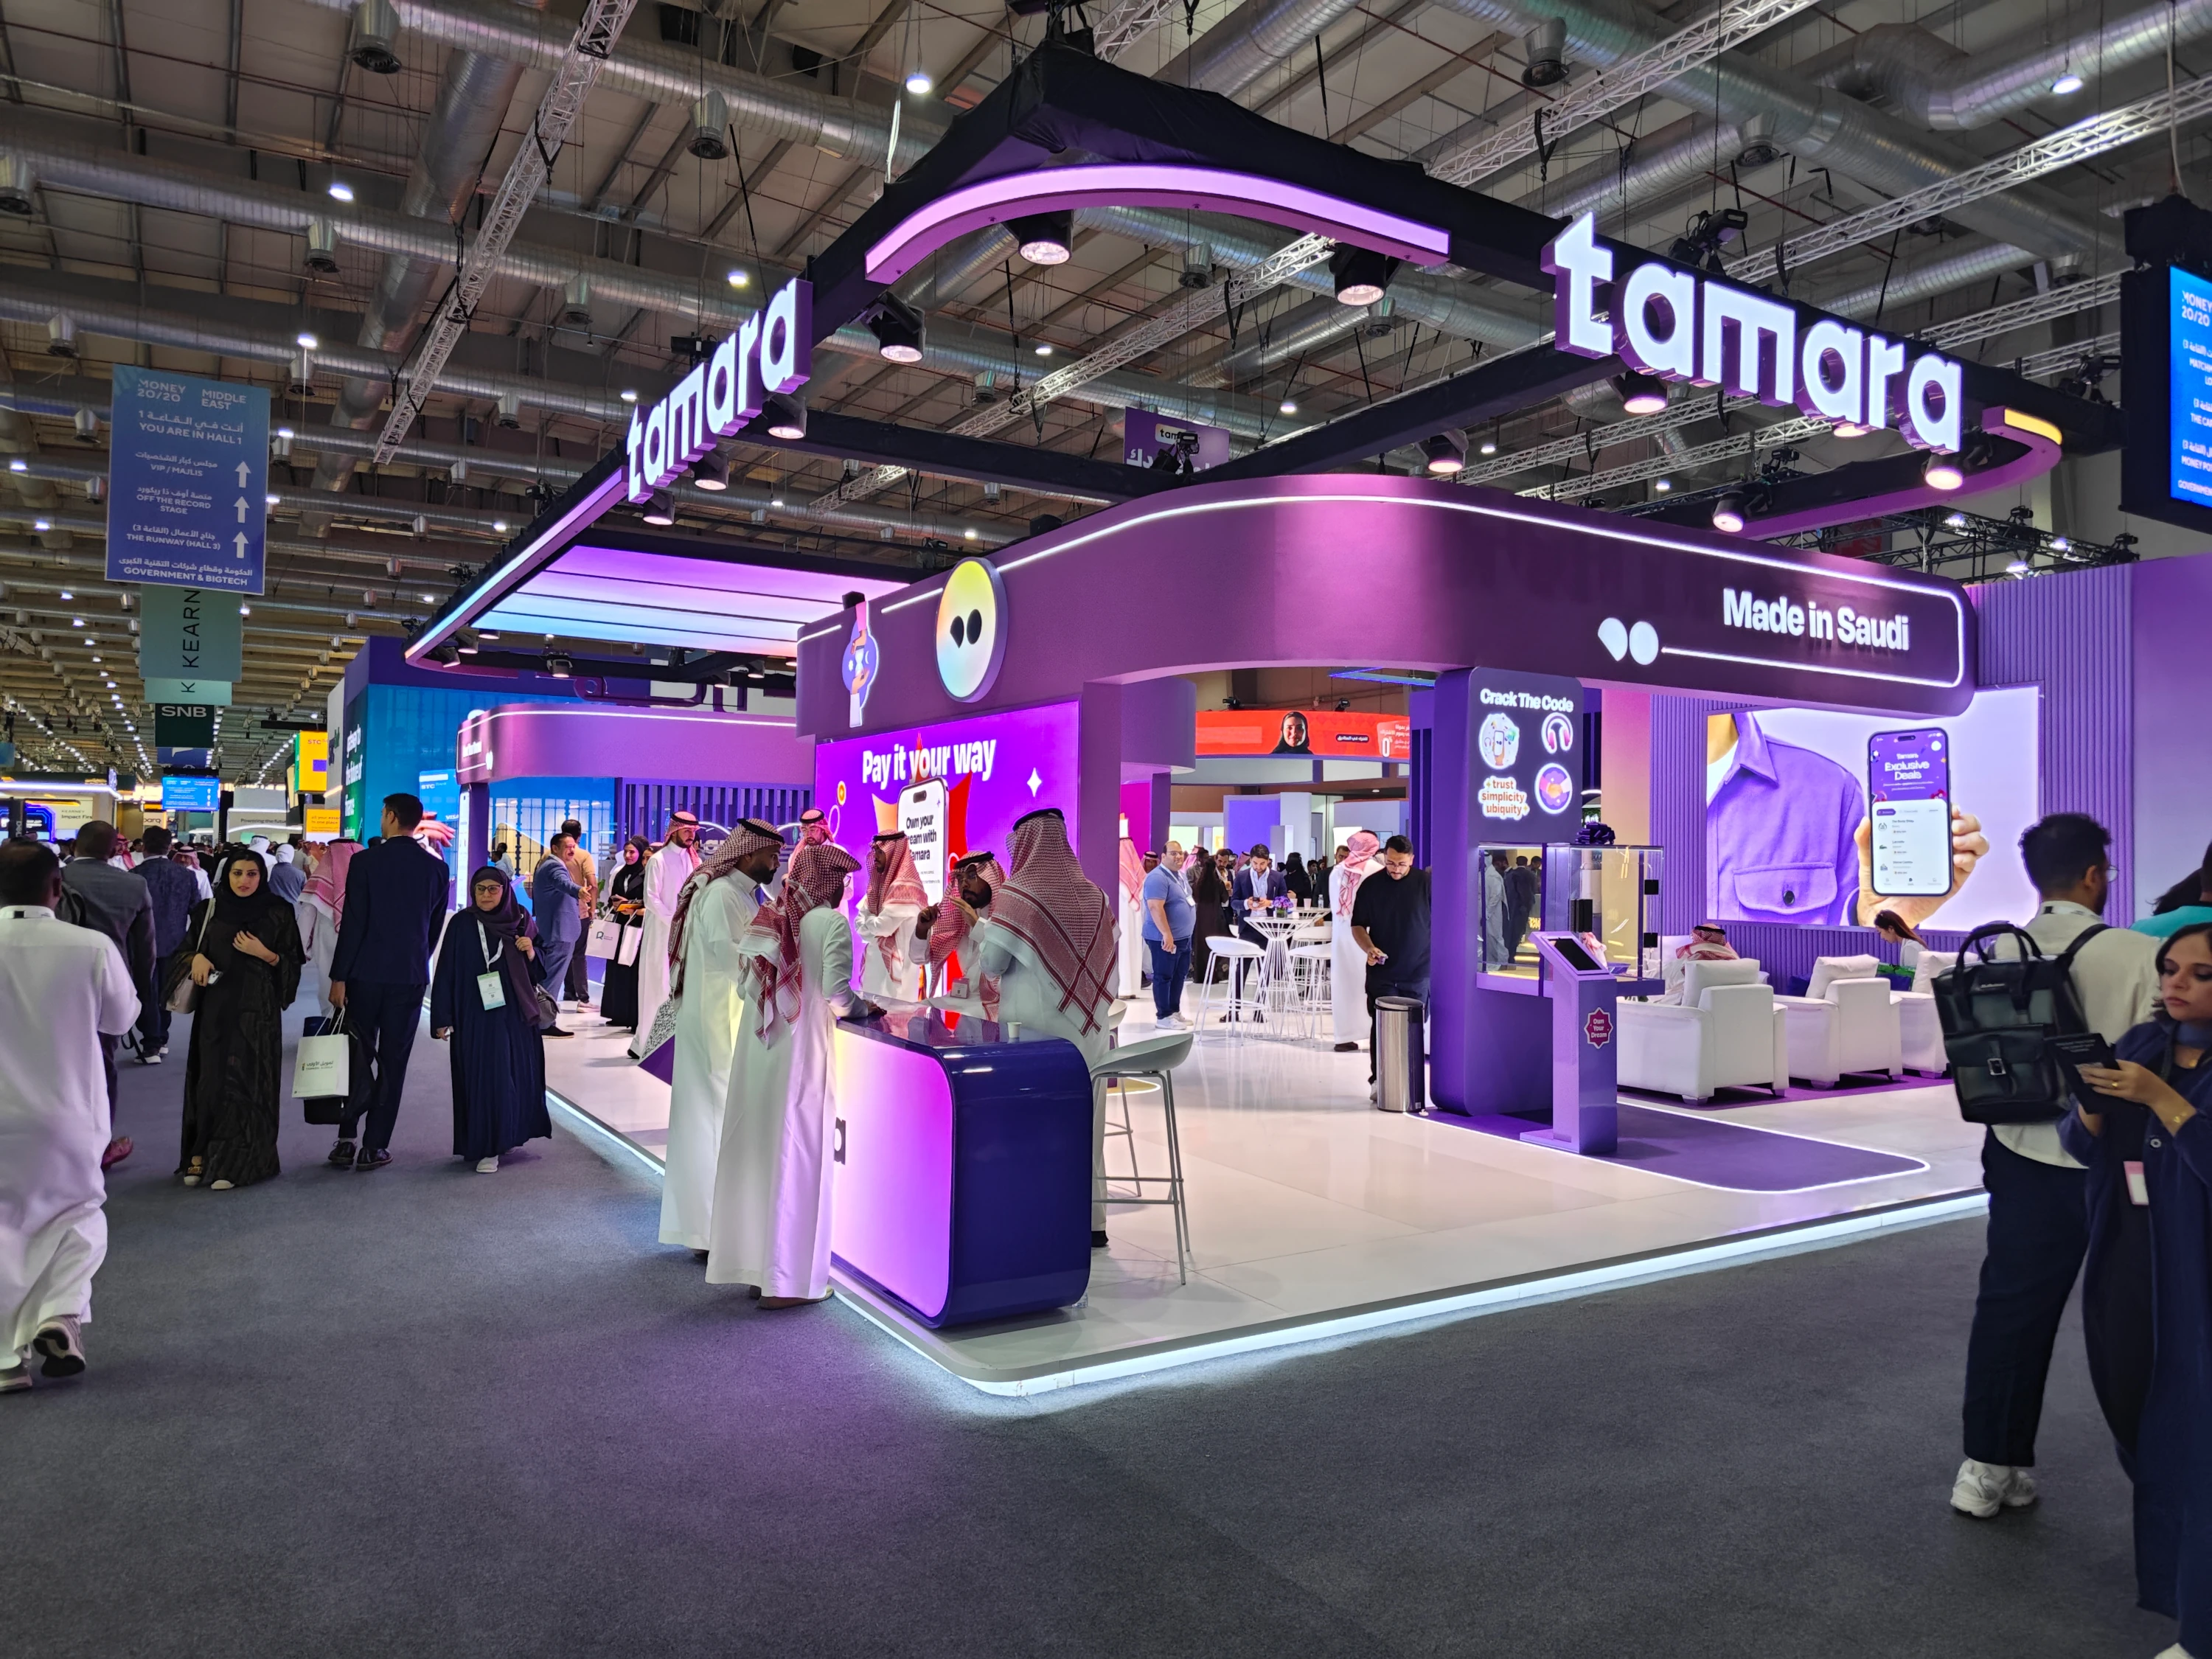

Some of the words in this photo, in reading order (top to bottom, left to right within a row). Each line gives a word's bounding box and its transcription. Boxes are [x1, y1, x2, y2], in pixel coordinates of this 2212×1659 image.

[2181, 305, 2211, 327] 20/20
[1553, 210, 1962, 454] tamara
[138, 378, 186, 394] MONEY
[627, 277, 804, 504] tamara
[137, 388, 181, 403] 20/20
[201, 389, 246, 404] MIDDLE
[201, 398, 232, 410] EAST
[139, 422, 164, 434] YOU
[167, 427, 190, 437] ARE
[192, 430, 204, 440] IN
[206, 431, 236, 444] HALL
[237, 437, 242, 445] 1
[195, 421, 219, 431] في
[220, 422, 244, 433] أنت
[1159, 428, 1179, 441] tam
[172, 467, 204, 477] MAJLIS
[136, 494, 155, 502] OFF
[156, 496, 173, 505] THE
[175, 498, 212, 509] RECORD
[160, 505, 188, 515] STAGE
[126, 533, 145, 542] THE
[146, 535, 185, 546] RUNWAY
[186, 540, 212, 550] (HALL
[212, 543, 221, 551] 3)
[123, 566, 196, 581] GOVERNMENT
[197, 574, 204, 582] &
[206, 574, 248, 586] BIGTECH
[1722, 587, 1805, 637] Made
[1807, 600, 1834, 641] in
[1837, 606, 1910, 651] Saudi
[1479, 688, 1518, 708] Crack
[1517, 692, 1542, 710] The
[1542, 695, 1574, 713] Code
[161, 706, 207, 717] SNB
[861, 750, 892, 790] Pay
[893, 743, 907, 781] it
[908, 744, 952, 785] your
[953, 739, 997, 782] way
[1885, 759, 1930, 772] Exclusive
[1894, 770, 1922, 781] Deals
[1492, 779, 1514, 789] trust
[1481, 790, 1525, 803] simplicity
[1486, 803, 1522, 816] ubiquity
[906, 817, 919, 830] Own
[919, 814, 934, 830] your
[908, 832, 922, 845] eam
[922, 829, 937, 844] with
